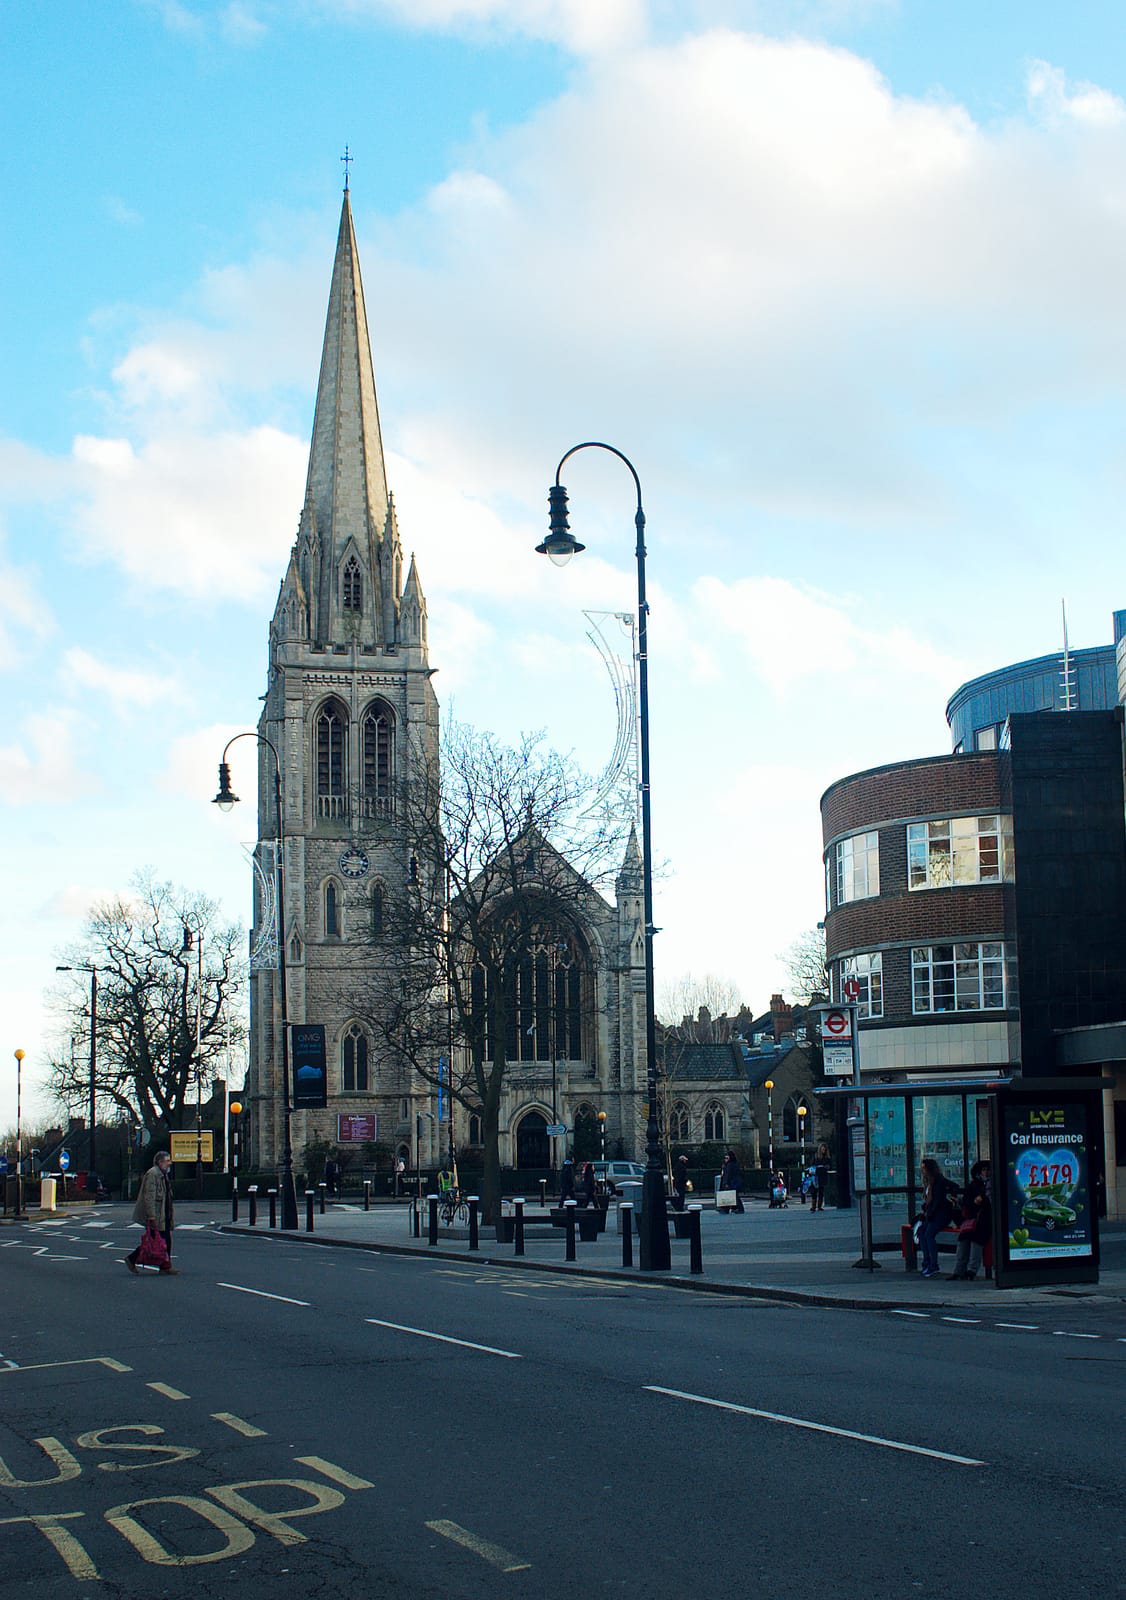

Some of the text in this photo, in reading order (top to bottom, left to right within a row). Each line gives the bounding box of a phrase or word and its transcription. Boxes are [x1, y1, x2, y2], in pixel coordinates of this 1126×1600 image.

[849, 982, 857, 995] L
[1010, 1132, 1083, 1145] Car Insurance
[1028, 1164, 1073, 1187] £179
